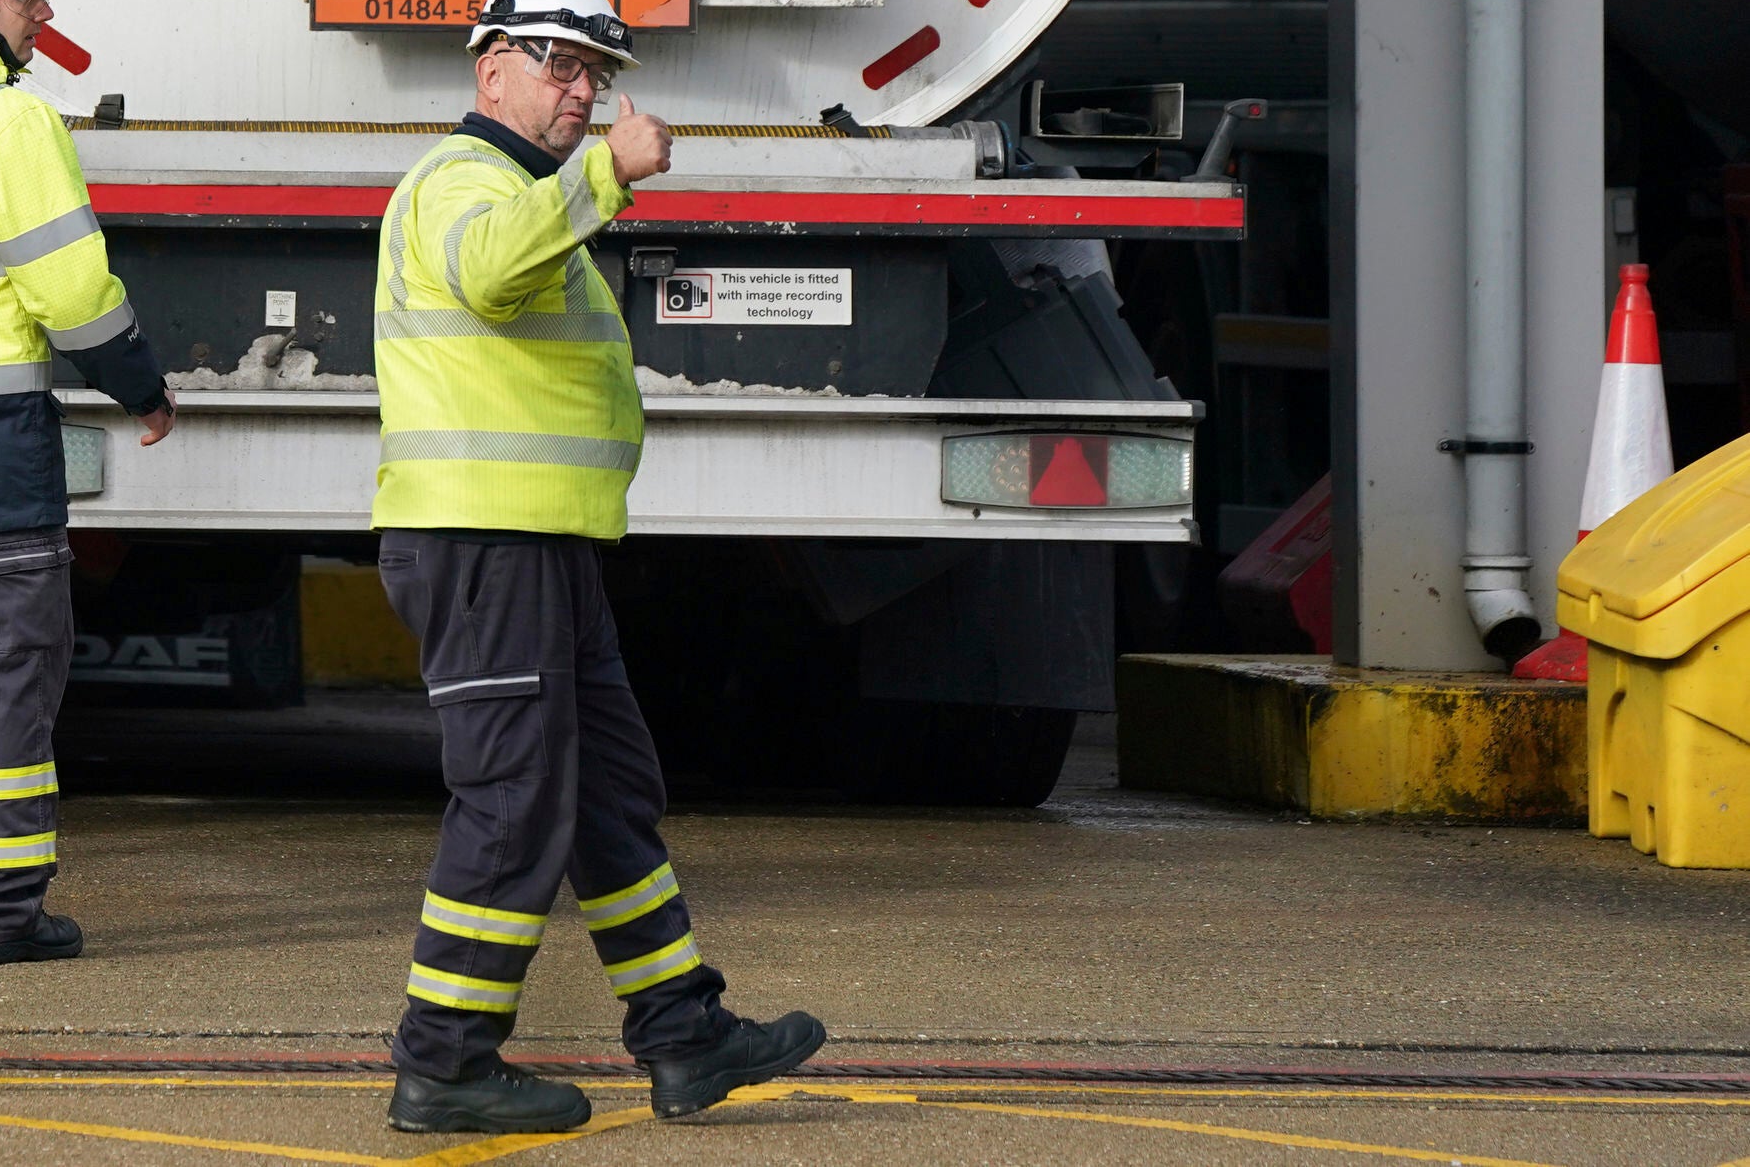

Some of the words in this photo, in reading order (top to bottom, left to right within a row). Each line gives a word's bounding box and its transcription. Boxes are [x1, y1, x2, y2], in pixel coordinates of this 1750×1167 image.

[721, 273, 746, 284] This
[750, 273, 791, 284] vehicle
[795, 273, 804, 284] is
[808, 273, 839, 284] fitted
[717, 290, 742, 301] with
[746, 290, 782, 303] image
[786, 290, 843, 303] recording
[747, 307, 813, 320] technology
[73, 635, 229, 667] DAF
